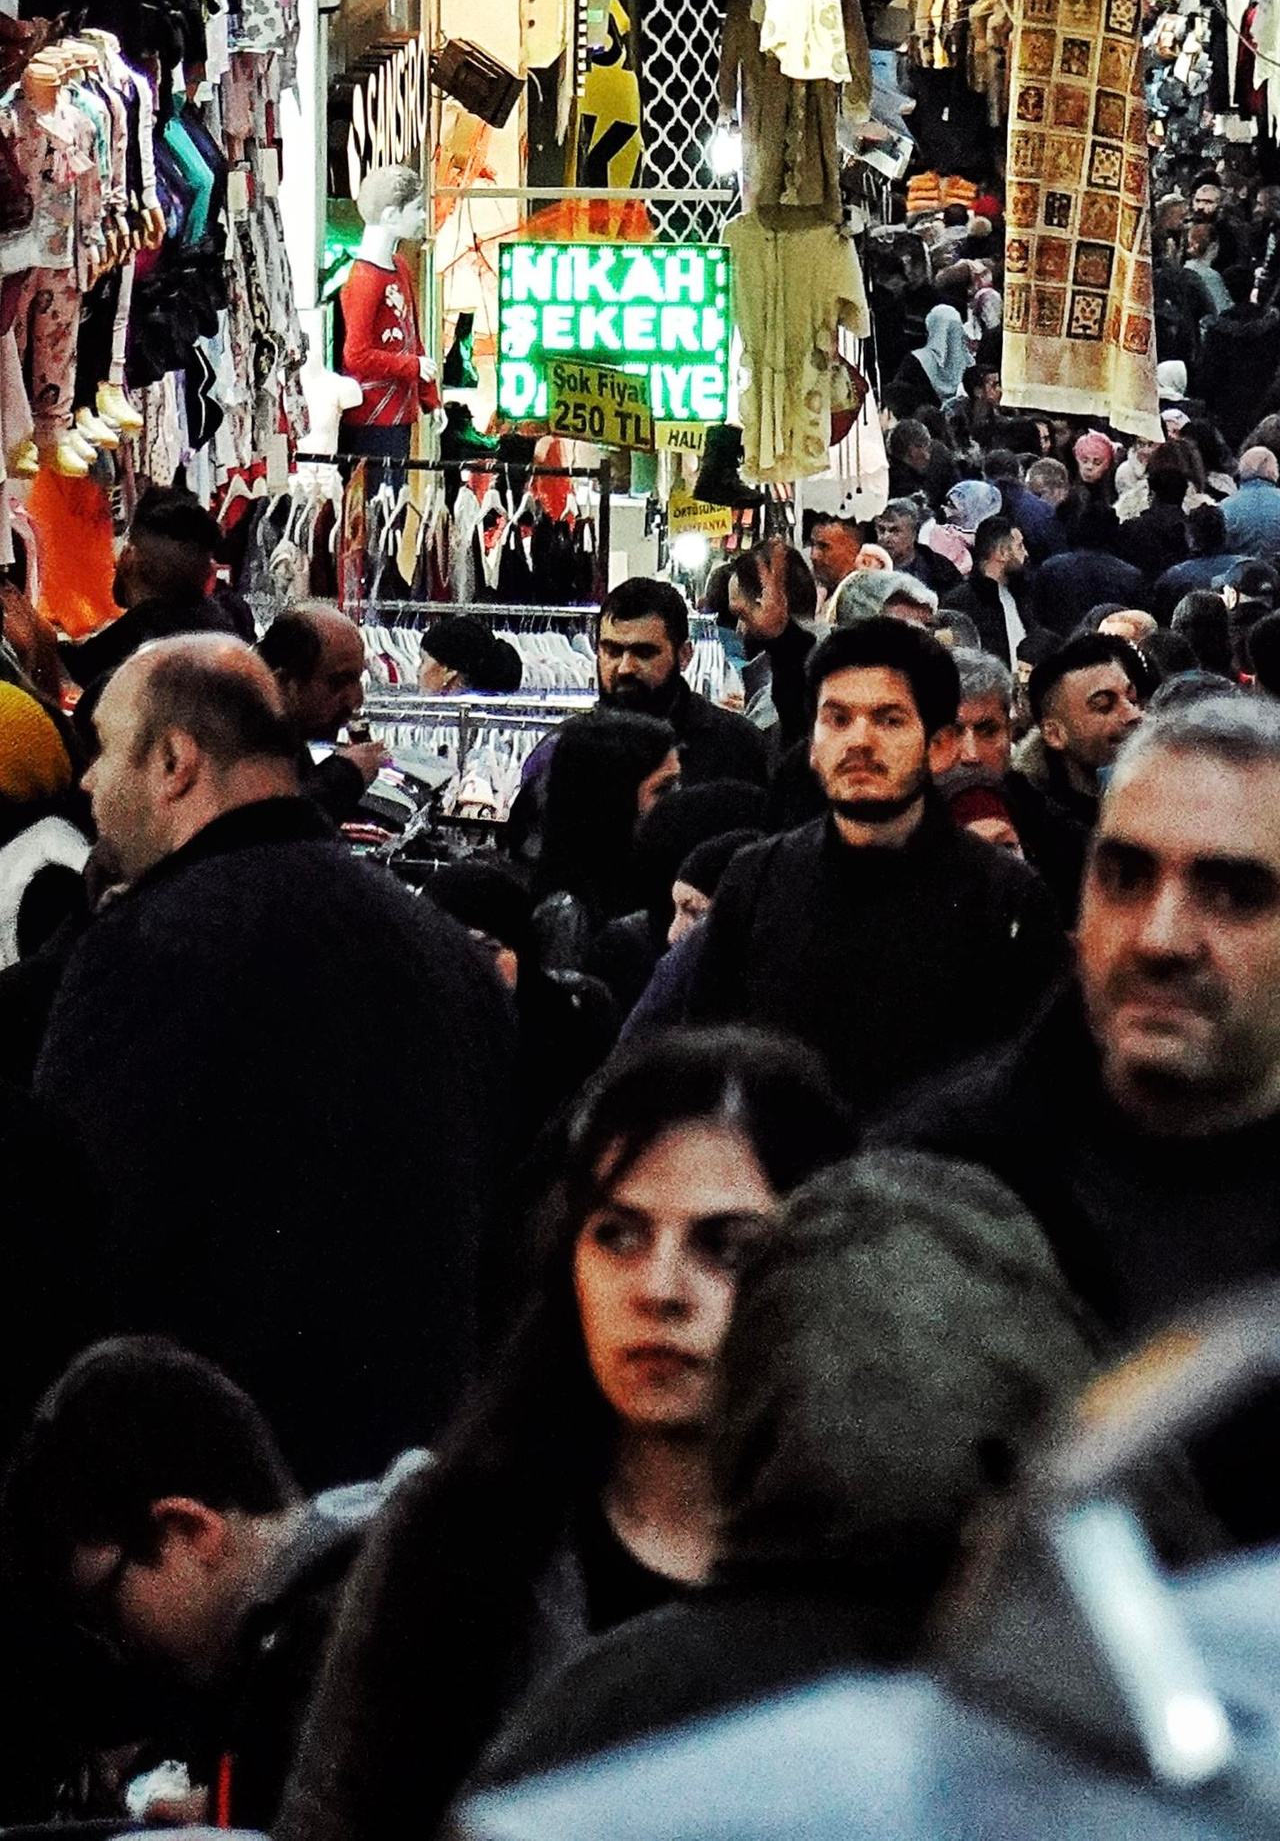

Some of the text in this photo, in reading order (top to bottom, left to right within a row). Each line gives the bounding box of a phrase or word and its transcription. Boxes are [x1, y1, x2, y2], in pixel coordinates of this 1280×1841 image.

[553, 364, 592, 395] Şok
[554, 400, 652, 447] 250 TL
